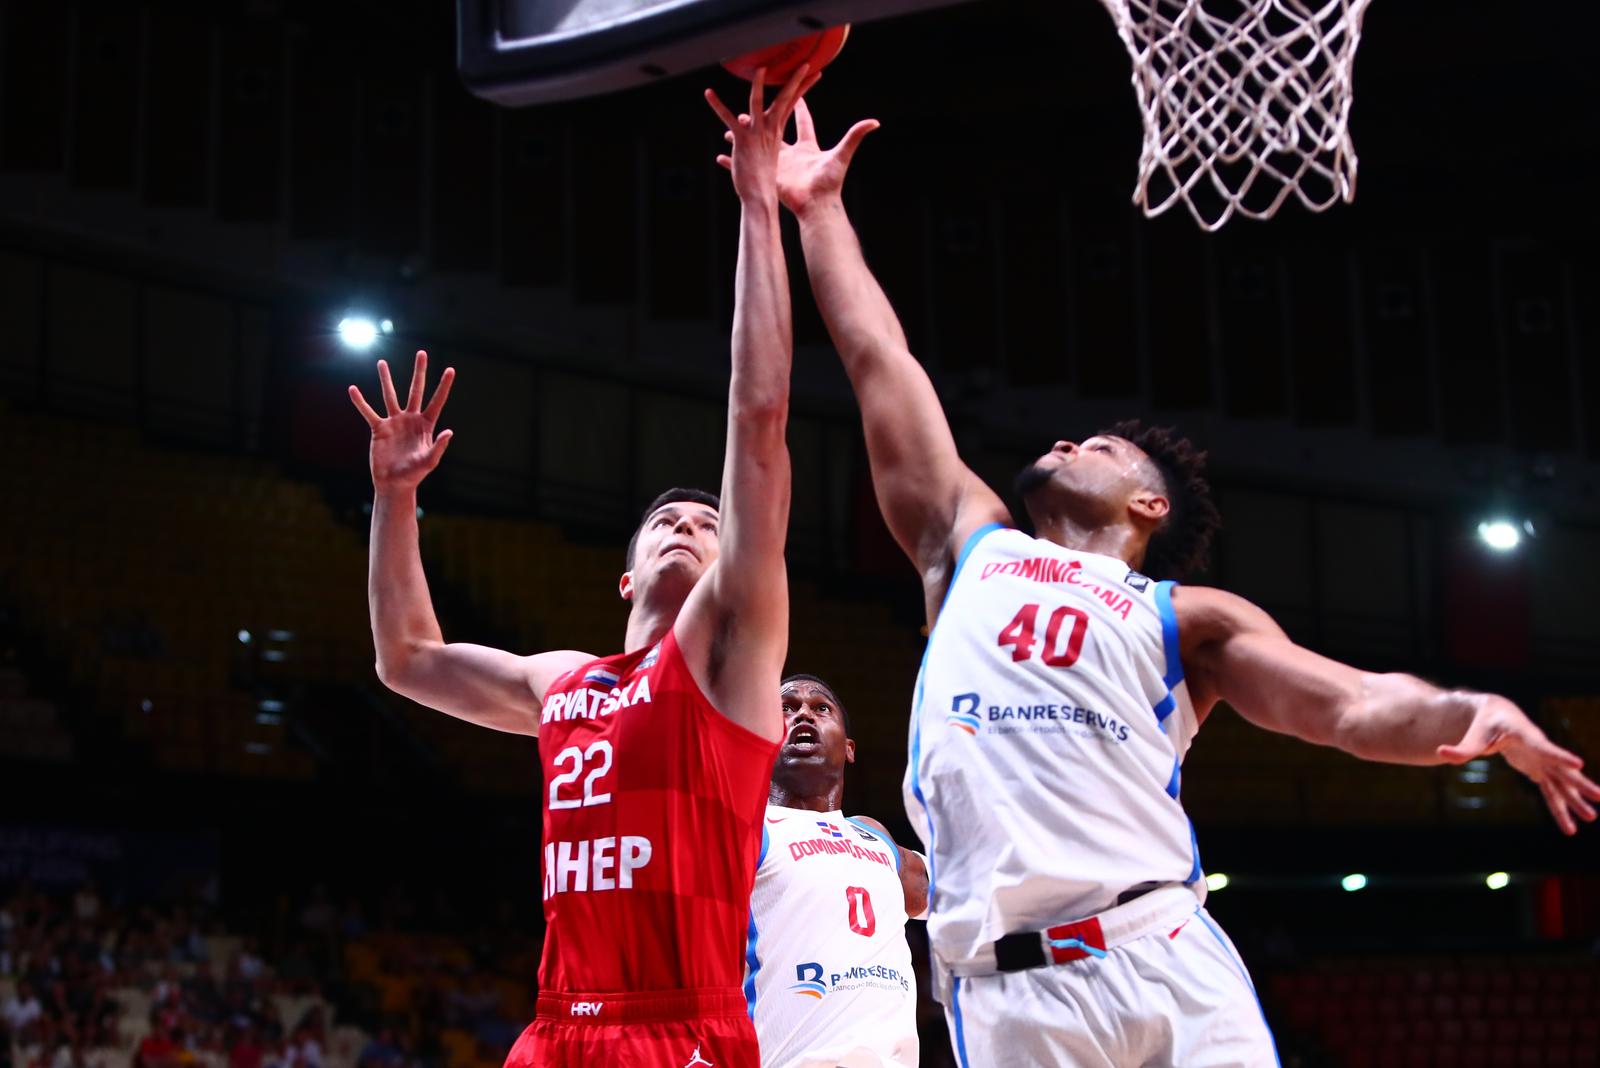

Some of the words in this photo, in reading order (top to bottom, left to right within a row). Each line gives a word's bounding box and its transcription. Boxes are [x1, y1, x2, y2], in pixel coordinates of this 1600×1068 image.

[980, 557, 1134, 620] DOMINICANA
[997, 603, 1090, 668] 40
[988, 704, 1129, 741] BANRESERVAS
[548, 739, 613, 811] 22
[788, 838, 893, 872] DOMINICANA
[845, 885, 876, 938] 0
[570, 1002, 603, 1016] HRV
